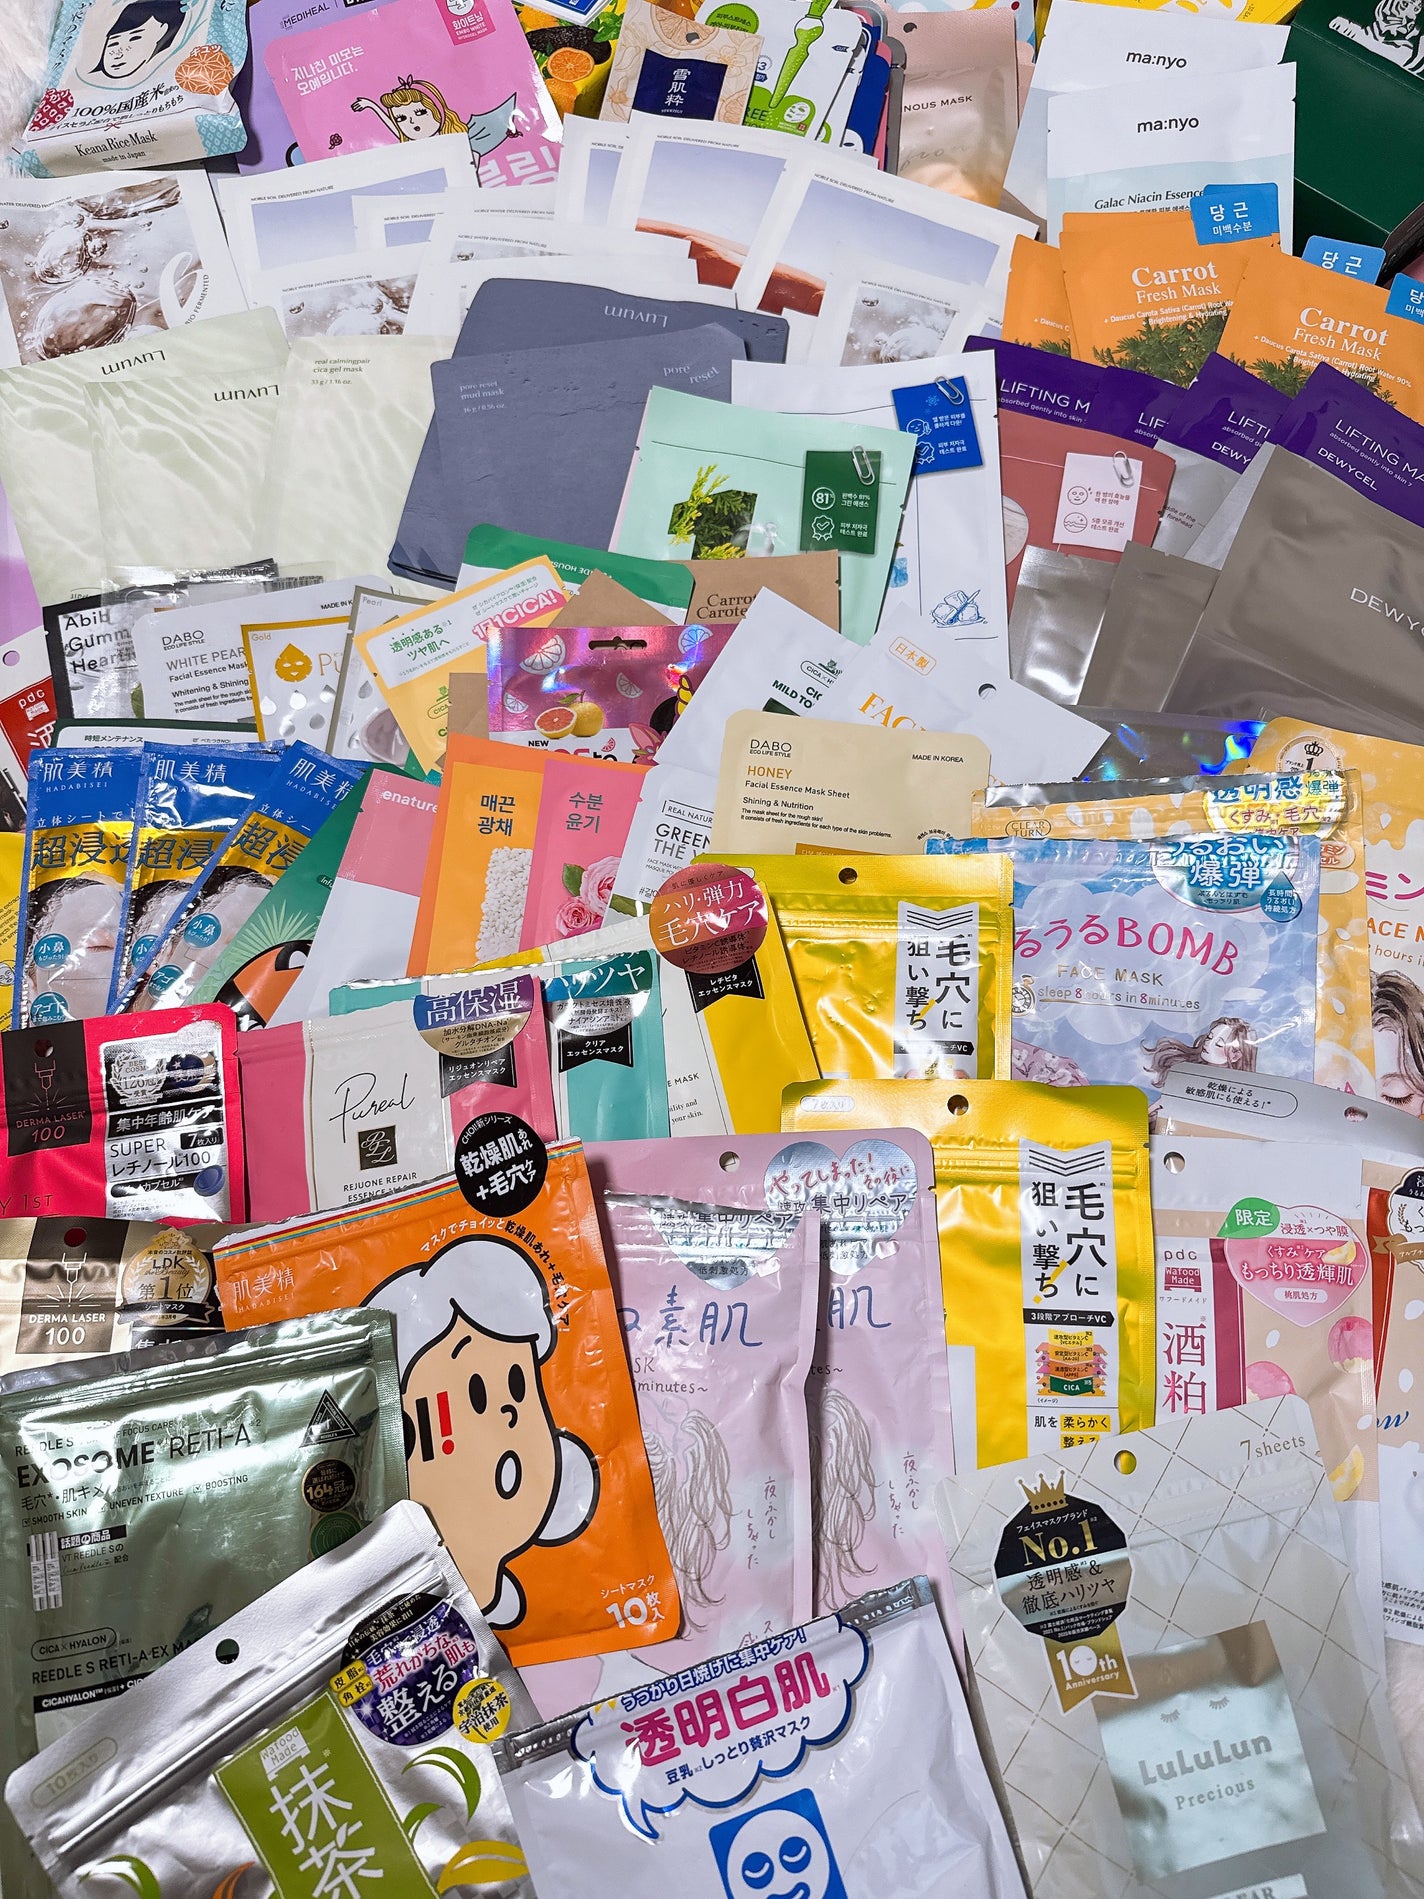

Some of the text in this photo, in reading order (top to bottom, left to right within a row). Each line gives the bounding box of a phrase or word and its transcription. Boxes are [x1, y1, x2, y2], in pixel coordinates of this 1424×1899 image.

[282, 2, 330, 27] MEDIHEAL
[452, 11, 483, 30] 화이트닝
[291, 45, 365, 82] 지나친 미모는
[1126, 51, 1187, 68] ma:nyo
[665, 67, 691, 107] 雪肌粋
[903, 94, 973, 113] NOUS MASK
[1137, 116, 1199, 133] ma:nyo
[102, 150, 146, 162] made in Japan
[1094, 195, 1125, 211] Galac
[1128, 191, 1163, 205] Niacin
[1165, 187, 1204, 200] Essence
[1212, 221, 1253, 236] 미백수분
[1131, 261, 1219, 288] Carrot
[1136, 281, 1222, 304] Fresh Mask
[1110, 300, 1222, 323] Daucus Carota Sativa (Carrot) Root
[1292, 327, 1383, 362] Fresh Mask
[312, 366, 327, 374] cica
[329, 366, 342, 374] gel
[314, 357, 371, 366] real calmingpair
[663, 365, 691, 377] pore
[460, 388, 505, 400] mud mask
[1317, 447, 1378, 491] DEWYCEL
[320, 603, 338, 611] MADE
[362, 596, 383, 607] Pearl
[162, 630, 204, 645] DABO
[251, 632, 272, 641] Gold
[406, 638, 451, 661] ツヤ肌へ
[893, 641, 931, 672] 日本製
[172, 679, 249, 698] Whitening & Shining
[84, 735, 144, 743] 時短メンテナンス
[749, 739, 792, 753] DABO
[43, 760, 114, 783] 肌美精
[154, 760, 227, 783] 肌美精
[747, 765, 793, 779] HONEY
[45, 782, 108, 793] HADABISEI
[745, 780, 850, 798] Facial Essence Mask Sheet
[480, 794, 516, 814] 매끈
[568, 791, 604, 811] 수분
[743, 797, 771, 807] Shining
[781, 800, 814, 811] Nutrition
[477, 816, 513, 837] 광채
[565, 813, 601, 834] 윤기
[646, 864, 665, 873] MASQUE
[1189, 859, 1263, 888] 爆弾
[1268, 889, 1293, 897] 長時間
[1264, 904, 1297, 914] 持続処方
[38, 939, 64, 954] 小鼻
[698, 980, 752, 997] エッセンスマスク
[426, 980, 523, 1025] 高保湿
[567, 1045, 624, 1056] エッセンスマスク
[585, 1040, 606, 1048] クリア
[448, 1059, 506, 1073] リジュオンリペア
[449, 1067, 506, 1081] エッセンスマスク
[674, 1072, 700, 1087] MASK
[1207, 1081, 1254, 1097] 乾燥による
[15, 1111, 84, 1129] DERMA LASER
[32, 1125, 66, 1142] 100
[110, 1138, 166, 1158] SUPER
[459, 1128, 533, 1178] 乾燥肌 あれ
[770, 1153, 874, 1195] やってしまった!
[1235, 1209, 1273, 1227] 限定
[1031, 1181, 1059, 1298] 狙い撃ち
[1064, 1182, 1107, 1297] 毛穴に
[153, 1256, 185, 1269] LDK
[1164, 1248, 1198, 1261] pdc
[1165, 1268, 1200, 1277] Wafood
[1171, 1276, 1195, 1286] Made
[1240, 1261, 1354, 1286] もっちり透輝肌
[138, 1276, 194, 1300] 第1位
[232, 1268, 295, 1297] 肌美精
[1160, 1296, 1207, 1305] ワフードメイド
[1284, 1289, 1318, 1301] 桃肌処方
[828, 1285, 892, 1330] 肌
[28, 1312, 106, 1325] DERMA LASER
[1030, 1312, 1107, 1324] 3段階アプローチVC
[45, 1327, 86, 1345] 100
[1162, 1322, 1207, 1415] 酒粕
[1063, 1384, 1080, 1392] CICA
[122, 1421, 174, 1436] FOCUS CARE
[1034, 1415, 1107, 1429] 肌を 柔らかく
[206, 1475, 248, 1490] BOOSTING
[110, 1488, 184, 1510] UNEVEN TEXTURE
[32, 1508, 87, 1525] SMOOTH SKIN
[1016, 1509, 1088, 1533] フェイスマスクブランド
[61, 1530, 111, 1549] 話題の商品
[1018, 1520, 1098, 1567] No.1
[114, 1554, 129, 1564] 配合
[600, 1574, 655, 1599] シートマスク
[1022, 1578, 1115, 1615] 徹底ハリツヤ
[39, 1635, 107, 1655] CICA HYALON
[444, 1641, 476, 1669] 肌も
[1065, 1671, 1120, 1691] Anniversary
[376, 1664, 458, 1737] 整える
[620, 1651, 830, 1767] 透明白肌
[458, 1693, 509, 1734] 宇治抹茶
[483, 1717, 499, 1732] 使用
[1175, 1778, 1255, 1810] Precious
[269, 1762, 384, 1899] 抹茶
